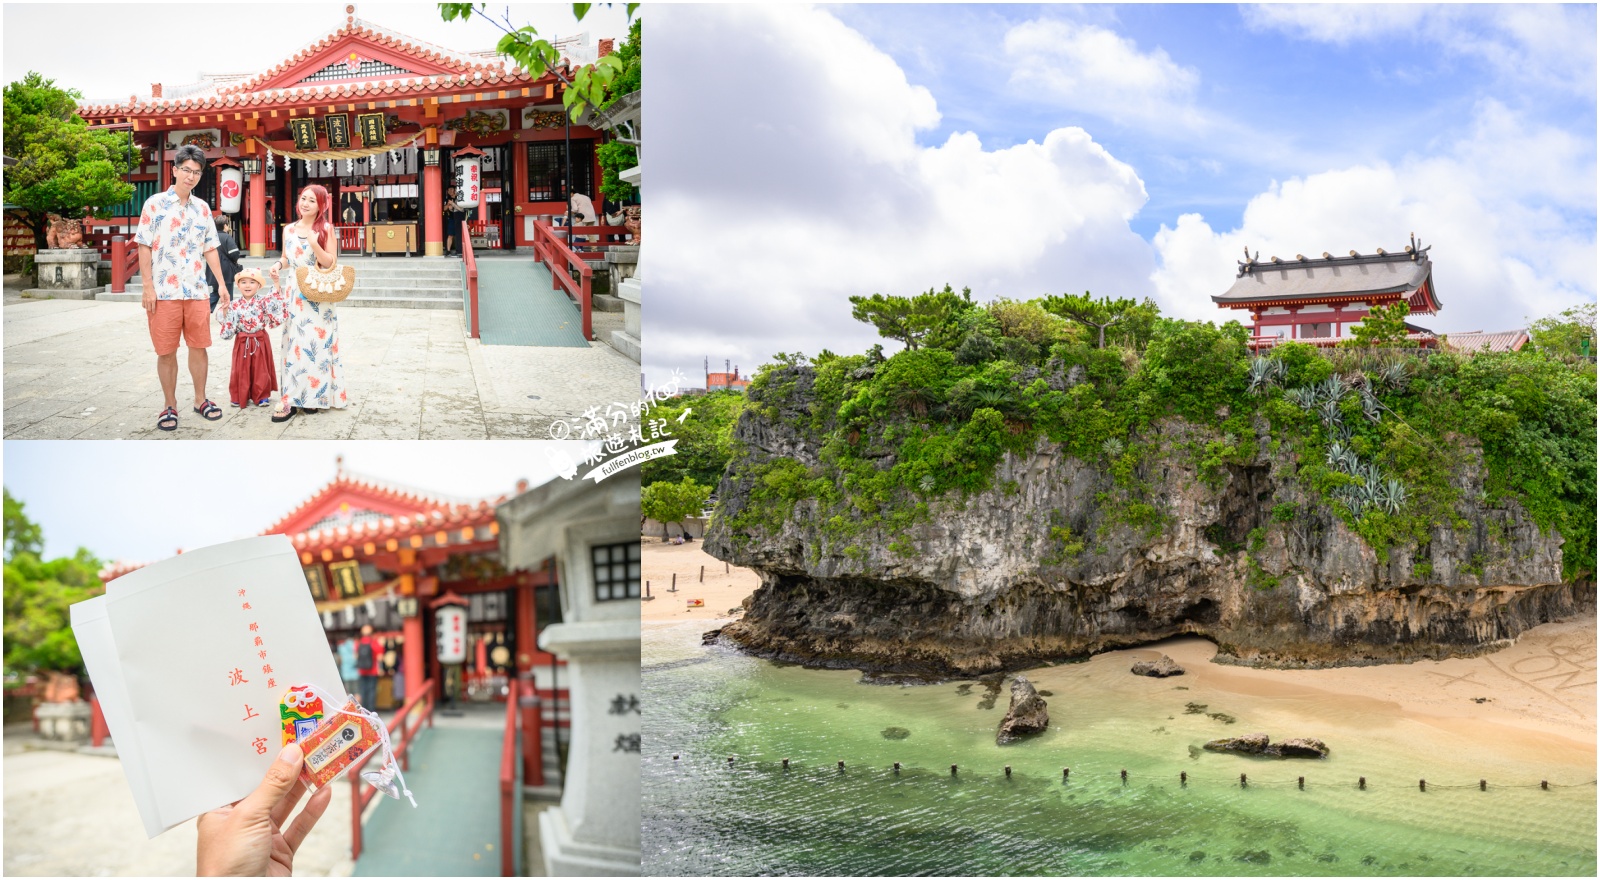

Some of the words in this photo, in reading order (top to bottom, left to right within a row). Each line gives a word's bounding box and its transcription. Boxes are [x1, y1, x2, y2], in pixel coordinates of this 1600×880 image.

[332, 119, 343, 143] 波上宮
[228, 667, 269, 755] 波上宮
